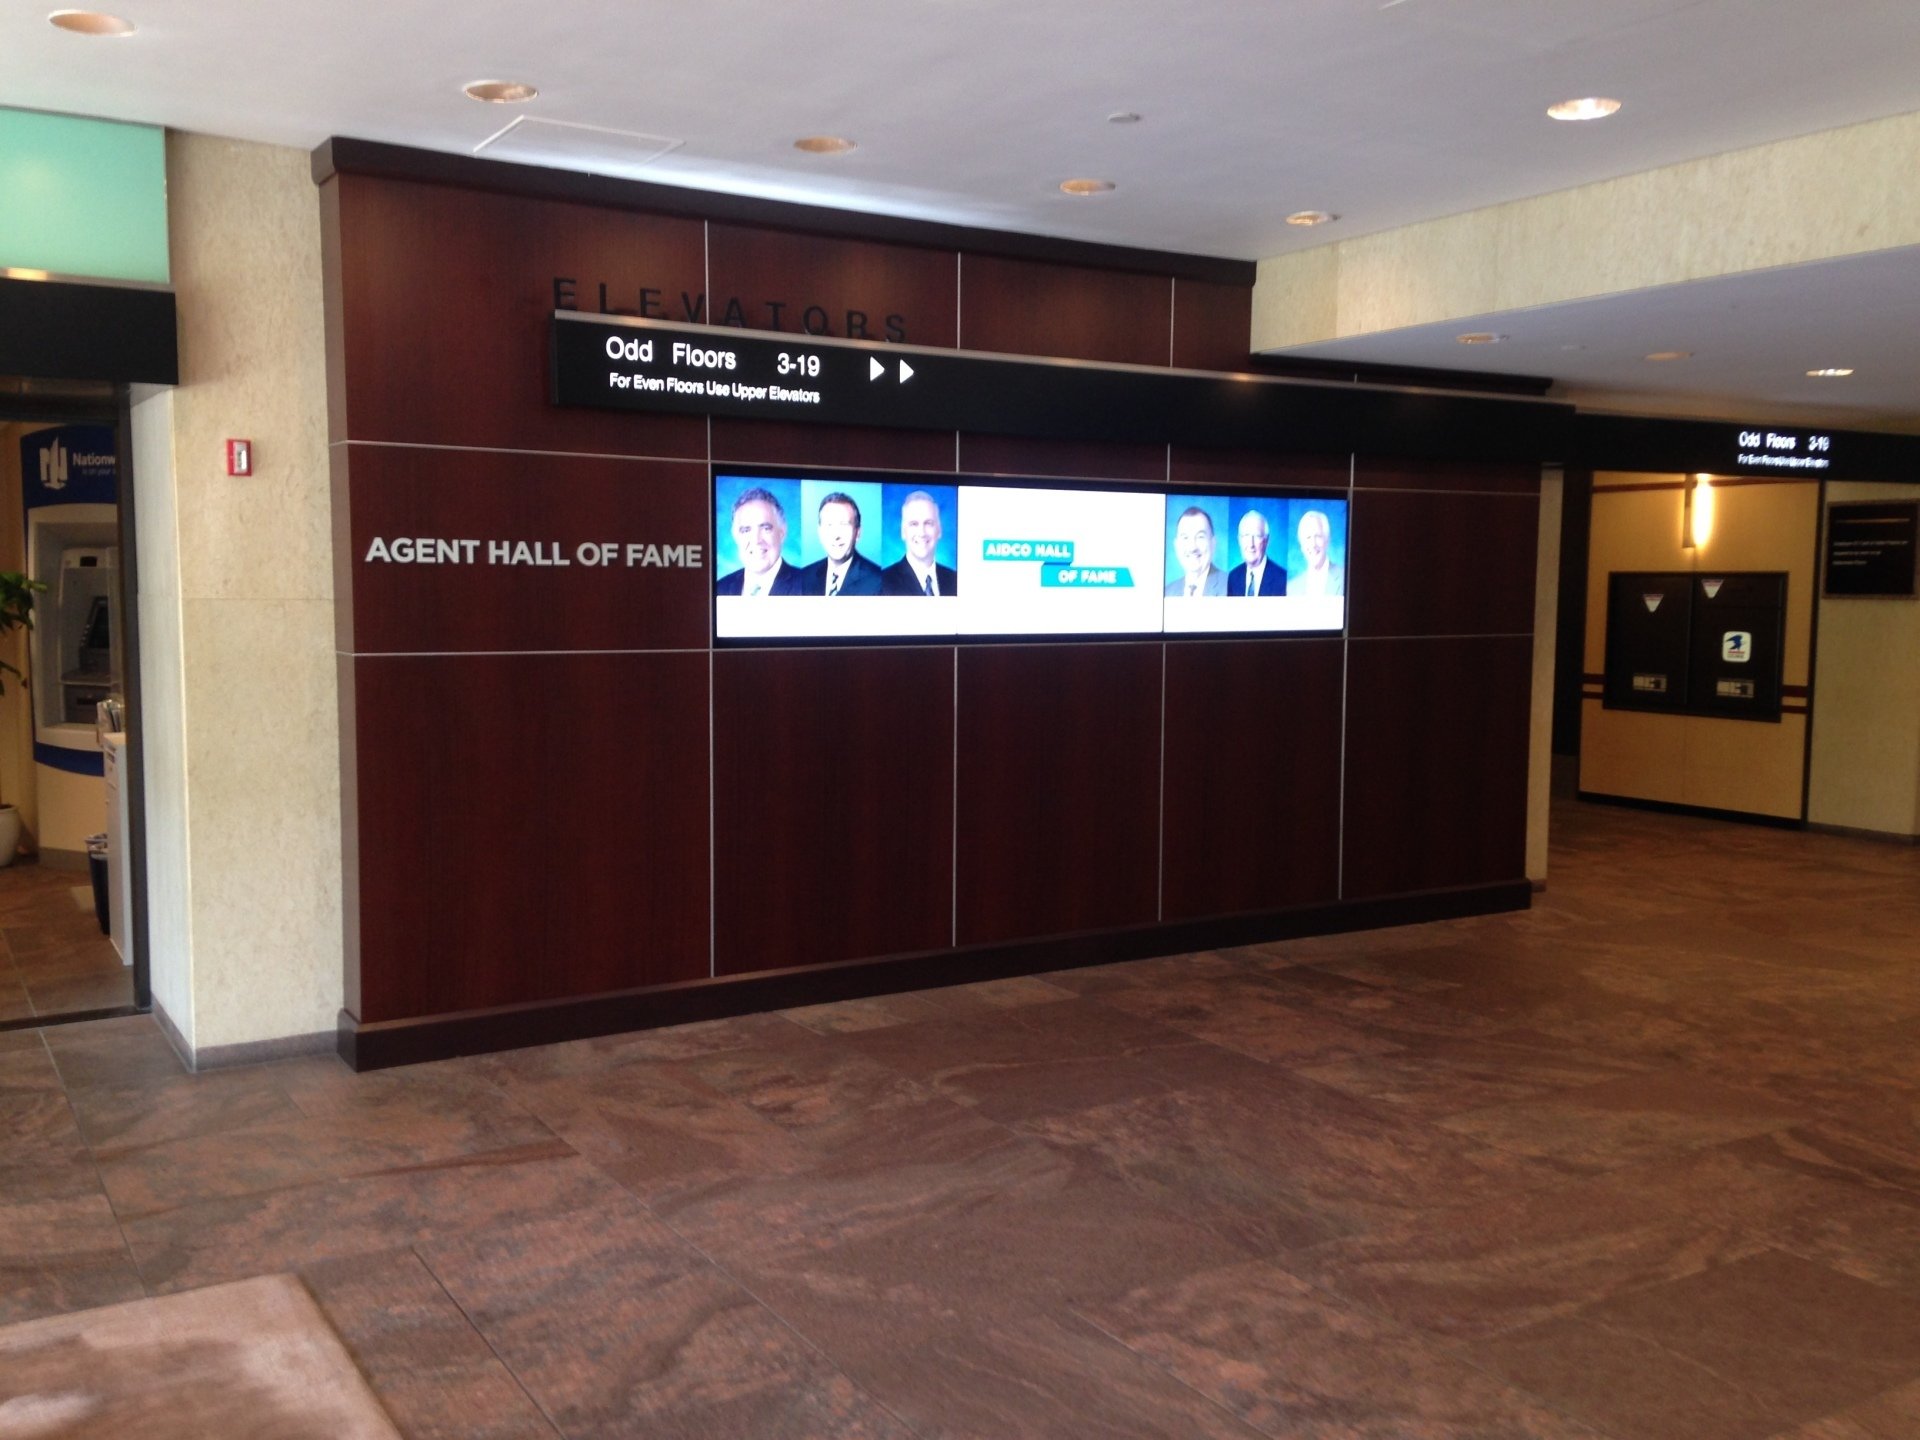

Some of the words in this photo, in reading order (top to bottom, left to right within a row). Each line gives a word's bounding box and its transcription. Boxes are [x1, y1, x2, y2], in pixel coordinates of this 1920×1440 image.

[553, 278, 907, 342] ELEVATORS
[605, 335, 653, 363] Odd
[672, 342, 737, 370] Floors
[776, 352, 821, 377] 3-19
[609, 372, 632, 389] For
[633, 374, 664, 391] Even
[666, 377, 705, 395] Floors
[706, 380, 730, 397] Use
[732, 384, 767, 401] Upper
[769, 385, 821, 404] Elevators
[1738, 431, 1761, 448] Odd
[1766, 432, 1796, 450] Floors
[364, 537, 480, 565] AGENT
[488, 540, 569, 566] HALL
[576, 542, 619, 567] OF
[626, 544, 703, 568] FAME
[986, 542, 1032, 557] AIDCO
[1035, 543, 1071, 558] HALL
[1058, 570, 1078, 583] OF
[1081, 570, 1117, 584] FAME
